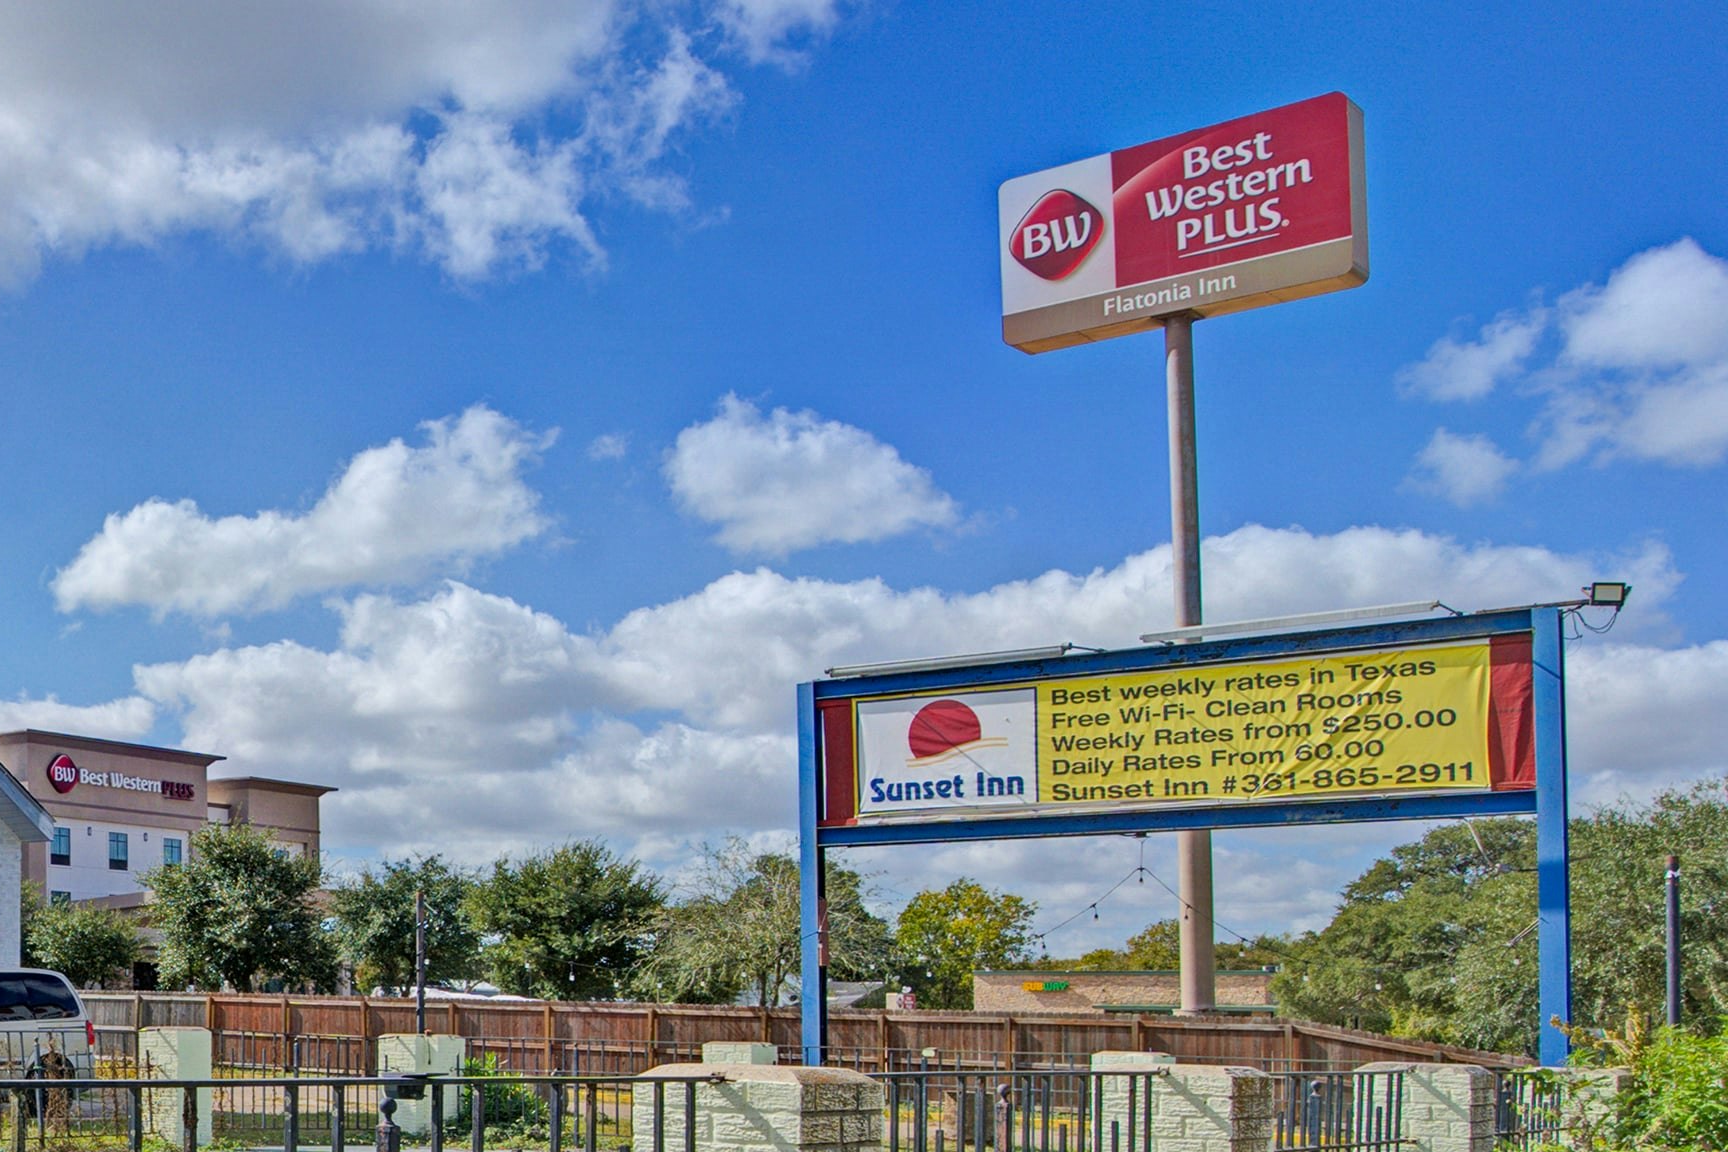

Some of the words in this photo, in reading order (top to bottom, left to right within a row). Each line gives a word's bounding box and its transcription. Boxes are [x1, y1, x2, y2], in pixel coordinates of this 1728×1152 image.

[1183, 131, 1273, 180] Best
[1145, 158, 1313, 221] Western
[1022, 211, 1091, 260] BW
[1177, 199, 1280, 251] PLUS
[1103, 283, 1191, 317] Flatonia
[1199, 274, 1236, 295] Inn
[1051, 686, 1112, 706] Best
[1119, 677, 1216, 700] weekly
[1225, 672, 1300, 692] rates
[1310, 667, 1334, 685] in
[1344, 660, 1437, 682] Texas
[1051, 711, 1110, 729] Free
[1119, 703, 1195, 724] Wi-Fi-
[1205, 698, 1286, 718] Clean
[1296, 689, 1403, 712] Rooms
[1051, 731, 1145, 752] Weekly
[1154, 727, 1234, 747] Rates
[1242, 722, 1312, 740] from
[1323, 708, 1457, 735] $250.00
[54, 766, 76, 782] BW
[79, 768, 109, 787] Best
[110, 772, 162, 793] Western
[1052, 756, 1114, 777] Daily
[1123, 753, 1202, 772] Rates
[1211, 748, 1284, 767] From
[1295, 739, 1385, 762] 60.00
[870, 775, 964, 803] Sunset
[976, 772, 1024, 797] Inn
[1051, 780, 1154, 801] Sunset
[1164, 778, 1209, 796] Inn
